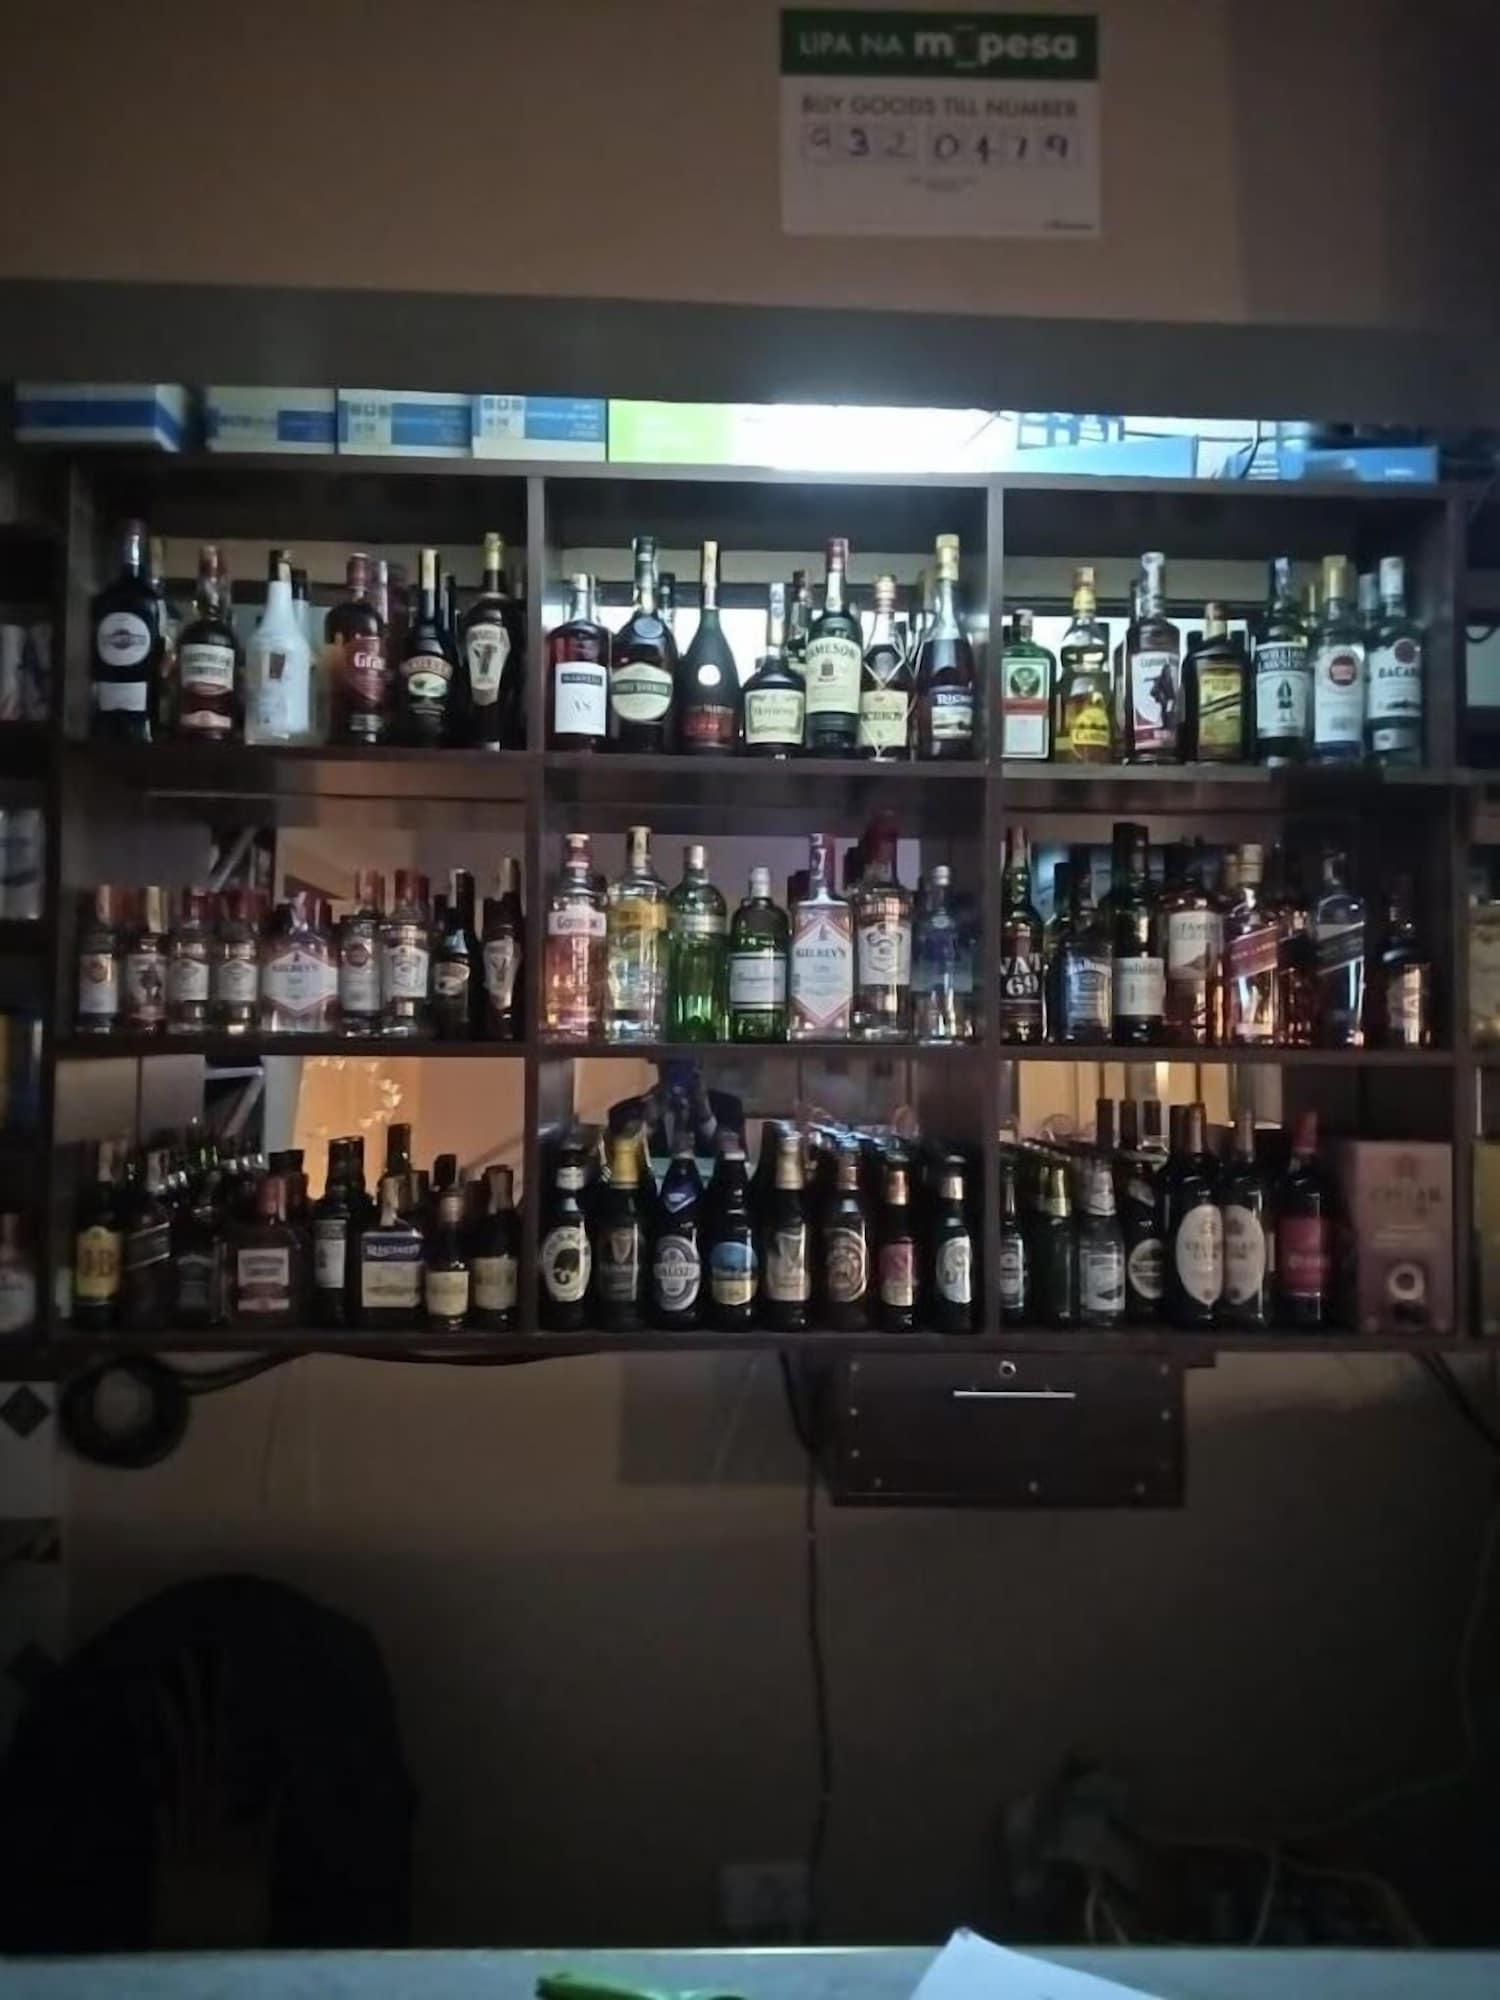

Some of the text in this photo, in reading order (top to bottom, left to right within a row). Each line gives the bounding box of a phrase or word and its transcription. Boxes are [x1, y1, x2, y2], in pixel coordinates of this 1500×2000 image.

[800, 31, 854, 56] LIPA
[861, 32, 905, 56] NA
[802, 95, 1078, 119] BUY GOODS TILL NUMBER
[1006, 976, 1038, 997] 69
